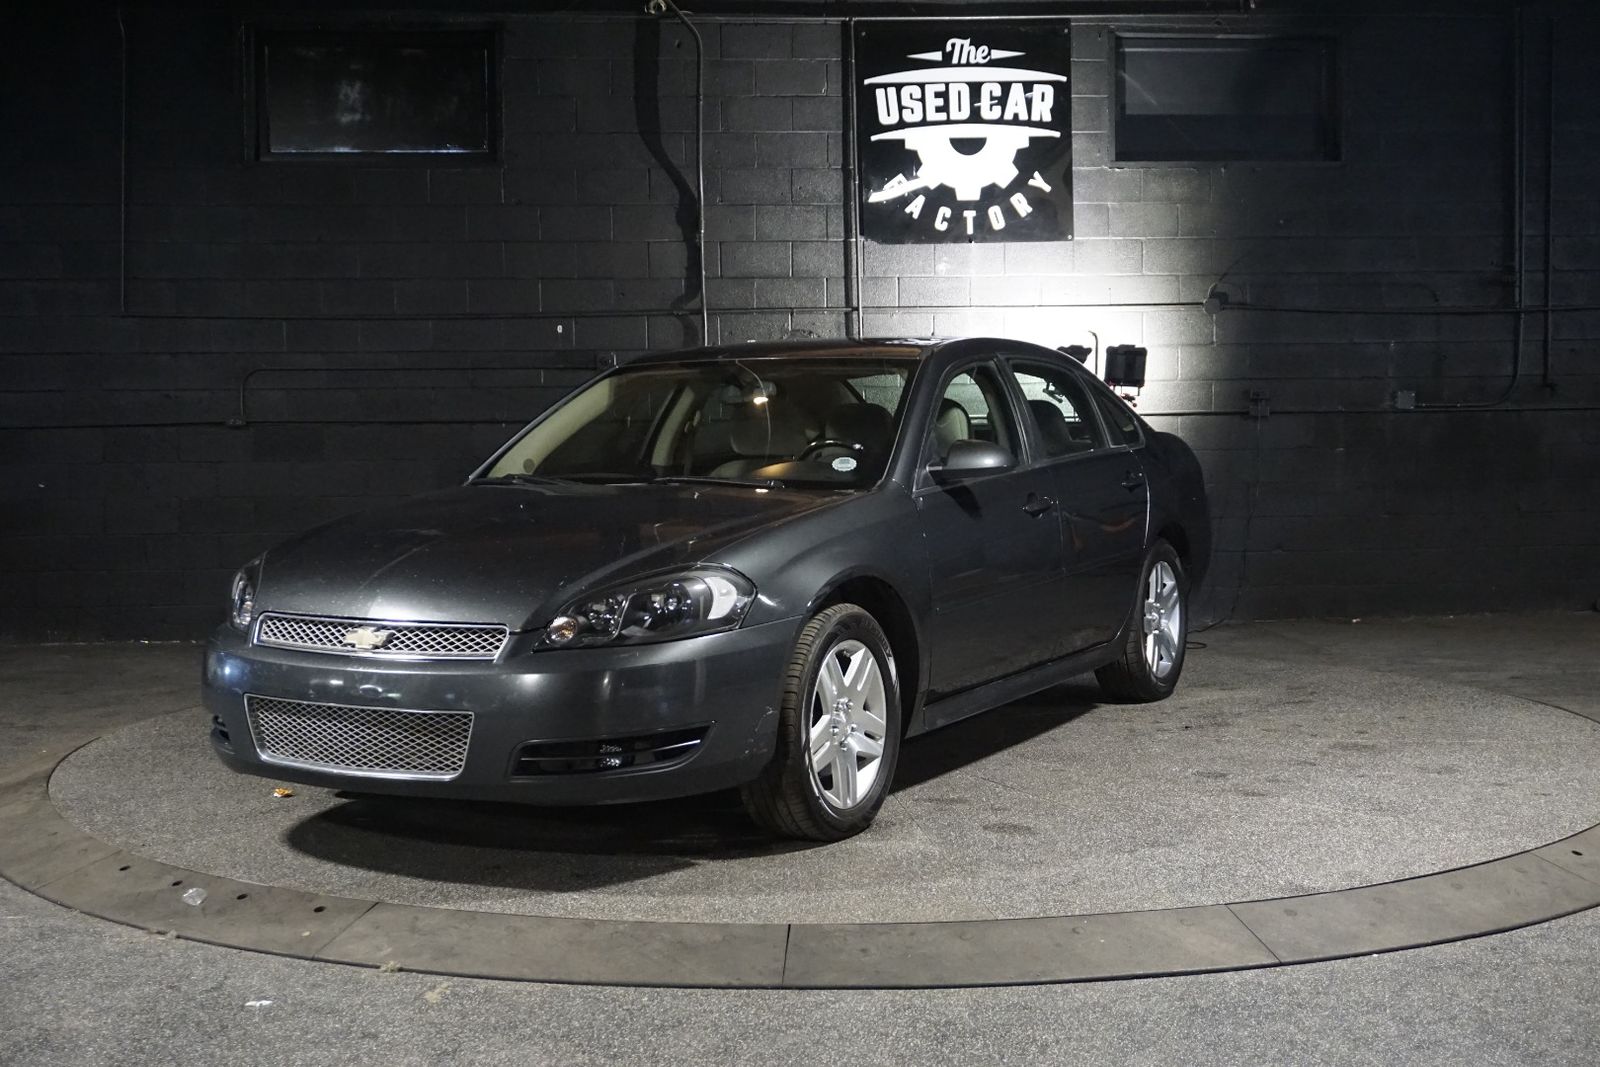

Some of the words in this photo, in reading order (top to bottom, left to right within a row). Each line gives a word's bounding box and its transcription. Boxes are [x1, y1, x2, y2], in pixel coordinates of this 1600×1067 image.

[946, 37, 991, 64] The
[875, 82, 971, 125] USED
[980, 82, 1055, 122] CAR
